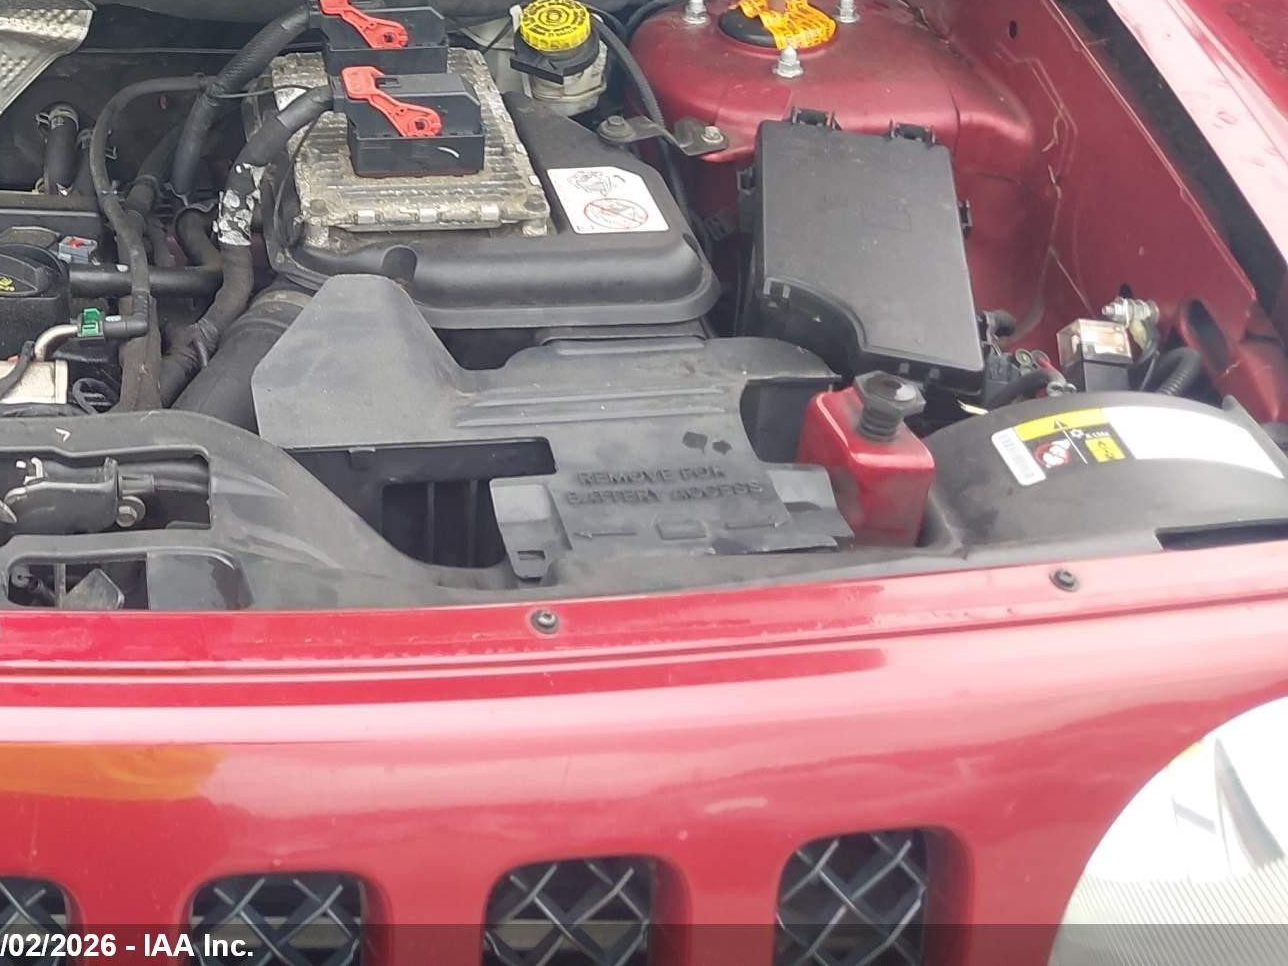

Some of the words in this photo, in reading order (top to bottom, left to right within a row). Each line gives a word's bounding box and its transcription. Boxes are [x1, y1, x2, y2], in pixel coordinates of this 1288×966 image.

[576, 469, 673, 486] REMOVE
[678, 466, 726, 481] FOR
[567, 490, 662, 506] BATTERY
[669, 482, 763, 502] ACCESS
